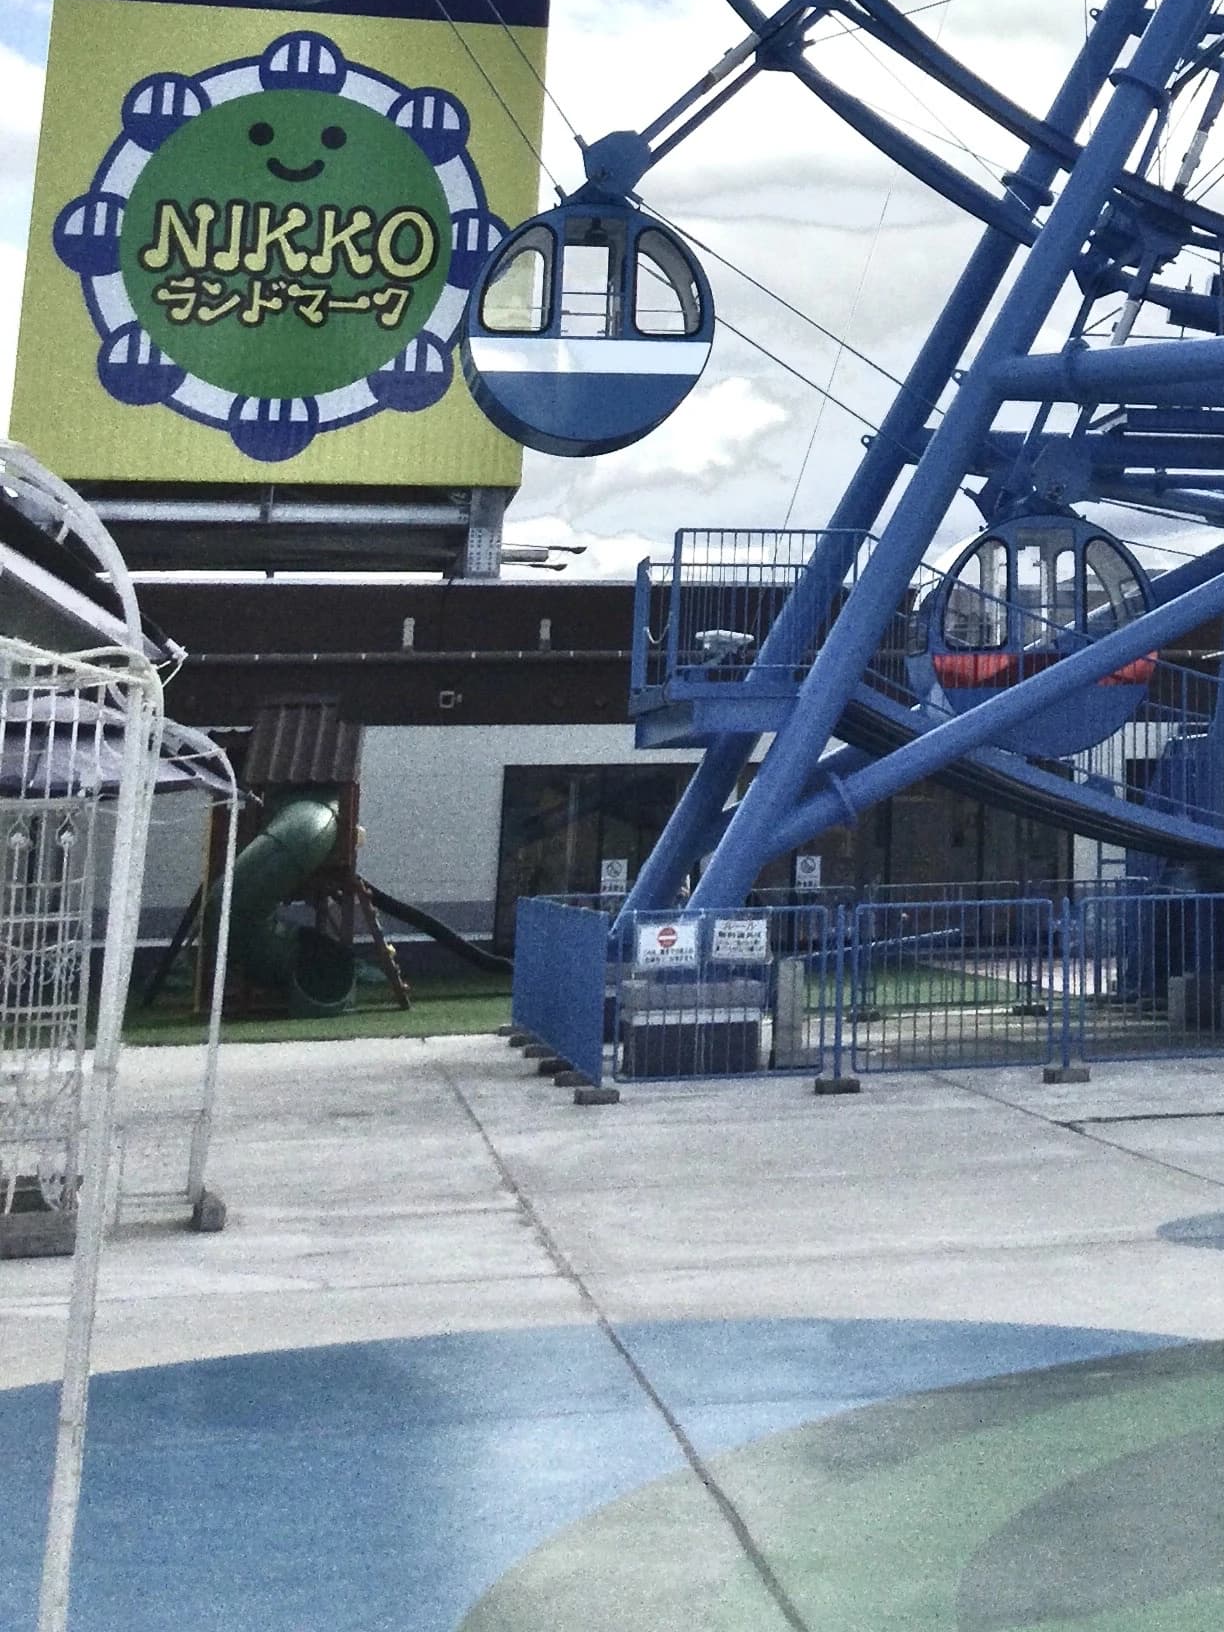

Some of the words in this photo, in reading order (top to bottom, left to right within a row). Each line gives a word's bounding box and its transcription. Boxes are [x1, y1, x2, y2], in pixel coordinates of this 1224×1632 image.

[142, 201, 437, 279] NIKKO
[156, 275, 410, 327] ランドマーク
